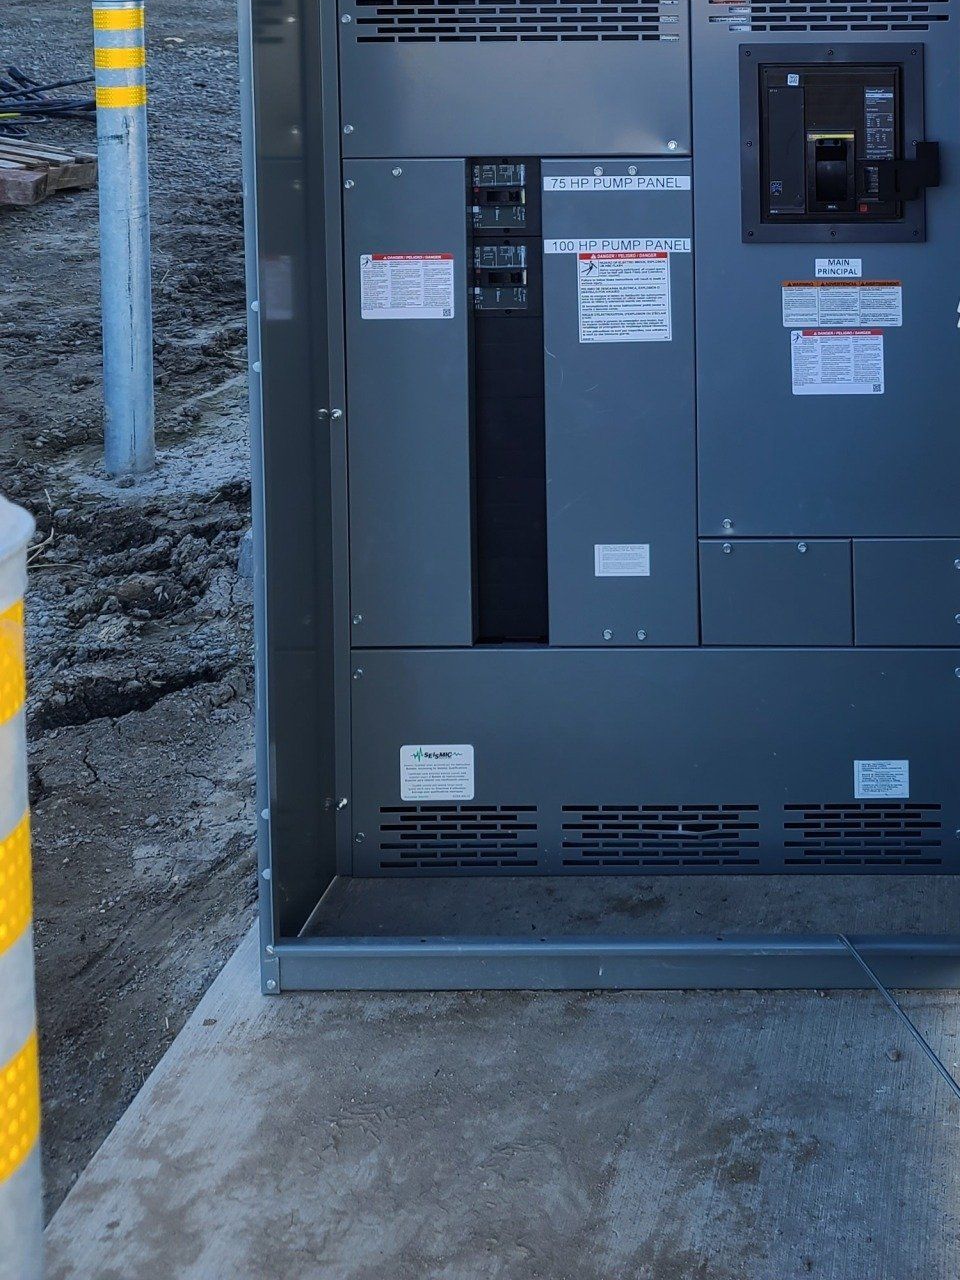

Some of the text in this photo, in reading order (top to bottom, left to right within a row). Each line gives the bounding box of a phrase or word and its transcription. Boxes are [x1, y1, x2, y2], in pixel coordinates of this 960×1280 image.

[550, 177, 682, 189] 75 HP PUMP PANEL
[552, 239, 690, 251] 100 HP PUMP PANEL
[817, 268, 858, 276] PRINCIPAL
[424, 751, 453, 760] SEISMIC
